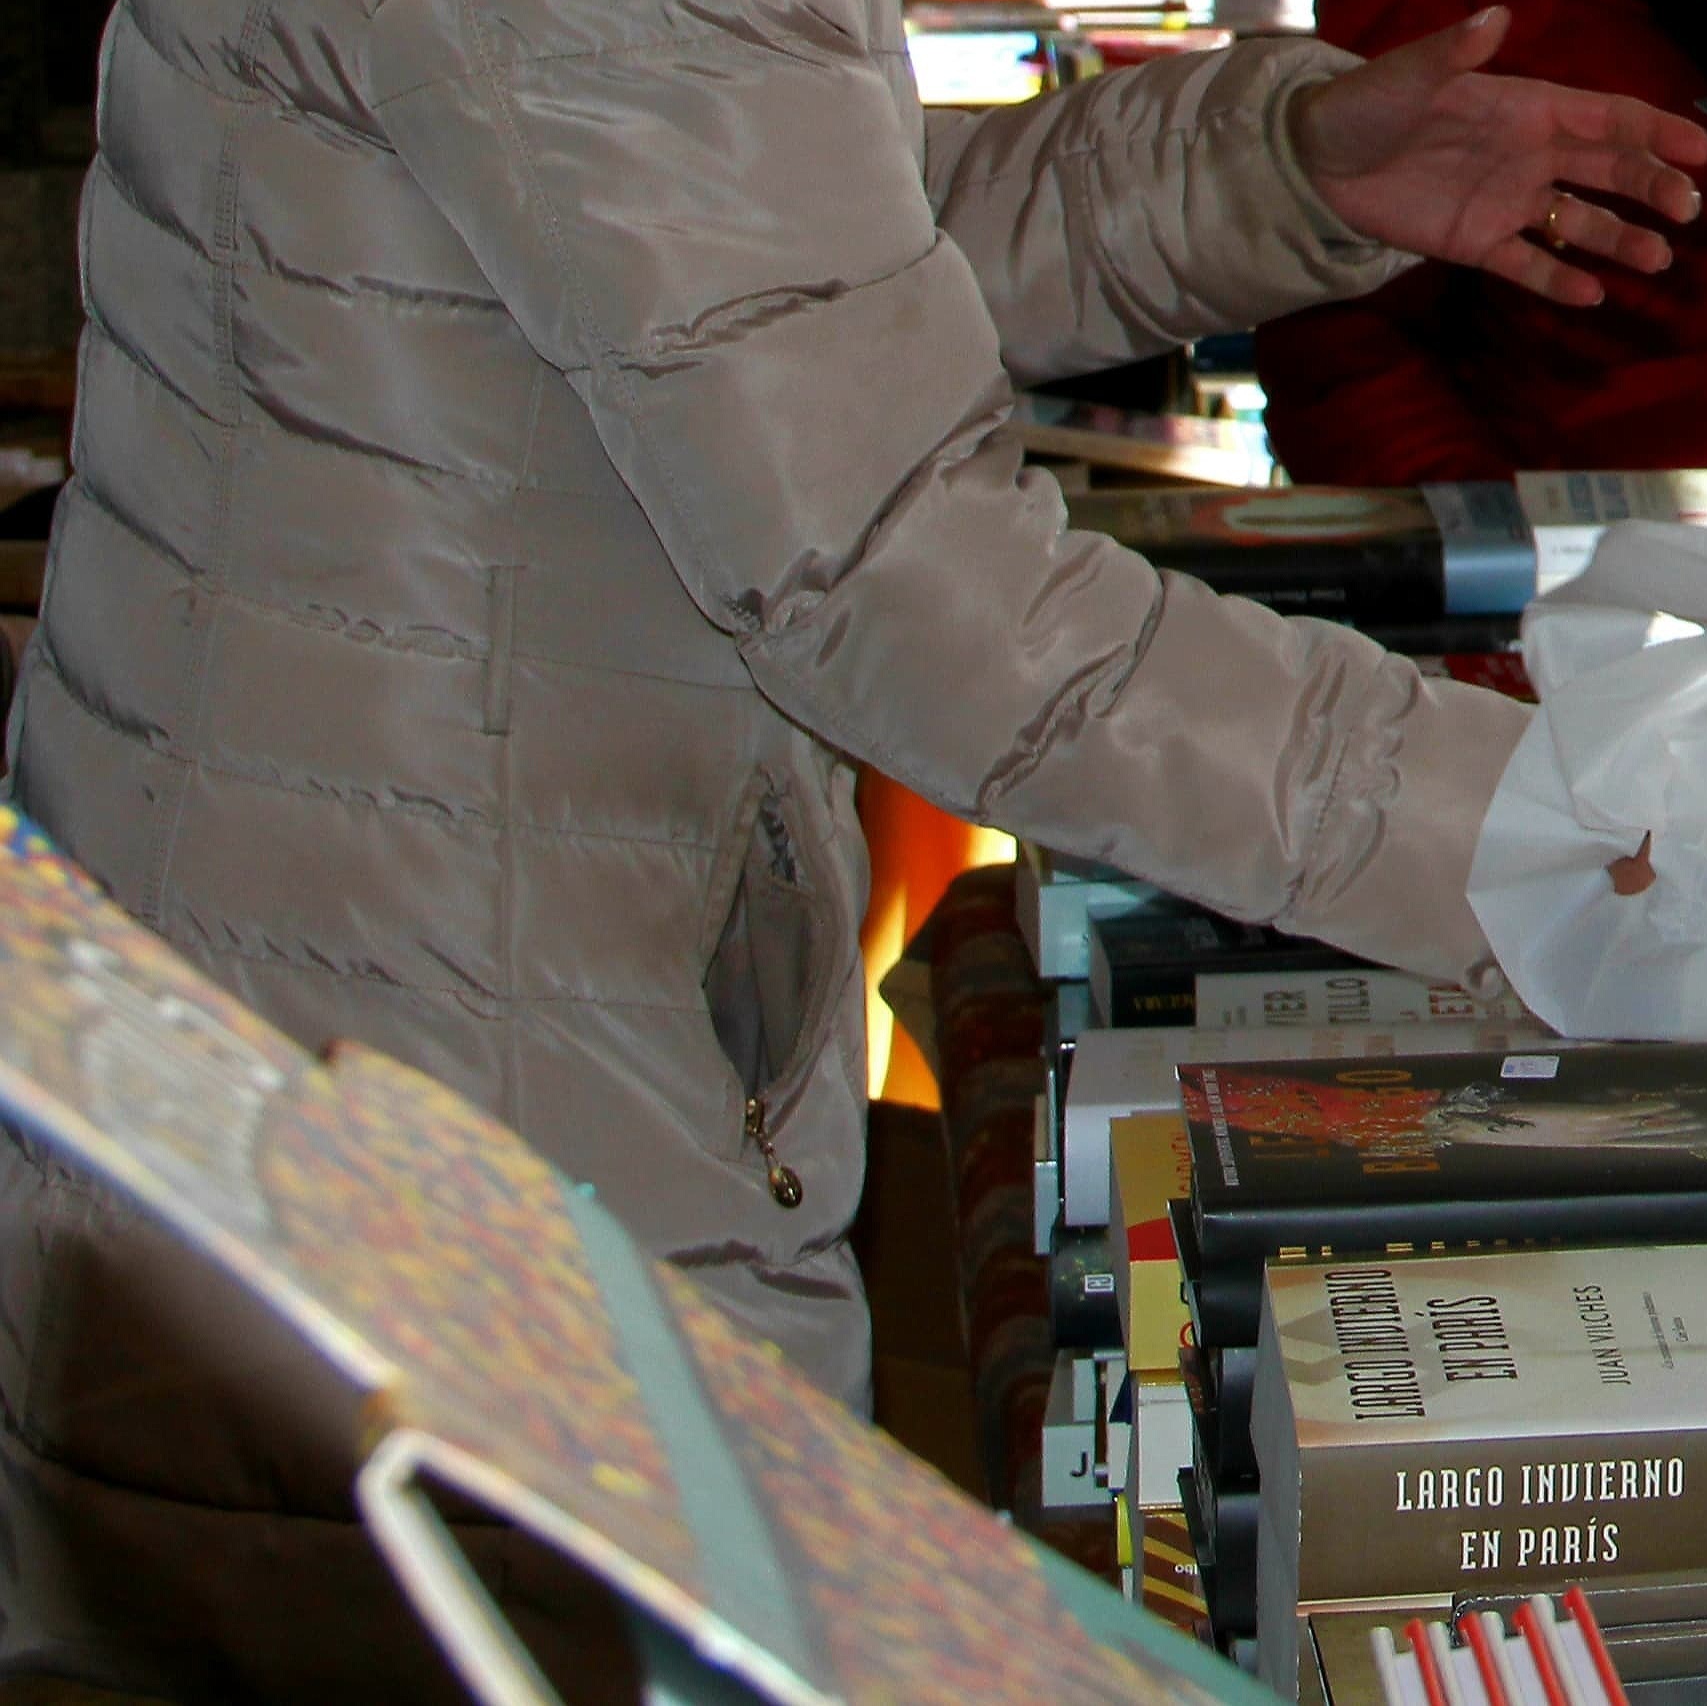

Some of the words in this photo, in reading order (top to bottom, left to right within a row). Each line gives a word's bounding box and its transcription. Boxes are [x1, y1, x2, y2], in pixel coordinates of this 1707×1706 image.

[1324, 1269, 1410, 1355] INVIERNO
[1414, 1295, 1510, 1352] PARÍS
[1572, 1283, 1622, 1346] VILCHES
[1344, 1357, 1426, 1421] LARGO
[1441, 1357, 1518, 1381] EN
[1597, 1346, 1632, 1386] JUAN
[1396, 1466, 1504, 1512] LARGO
[1520, 1455, 1686, 1507] INVIERNO
[1459, 1528, 1502, 1572] EN
[1516, 1516, 1621, 1568] PARÍS
